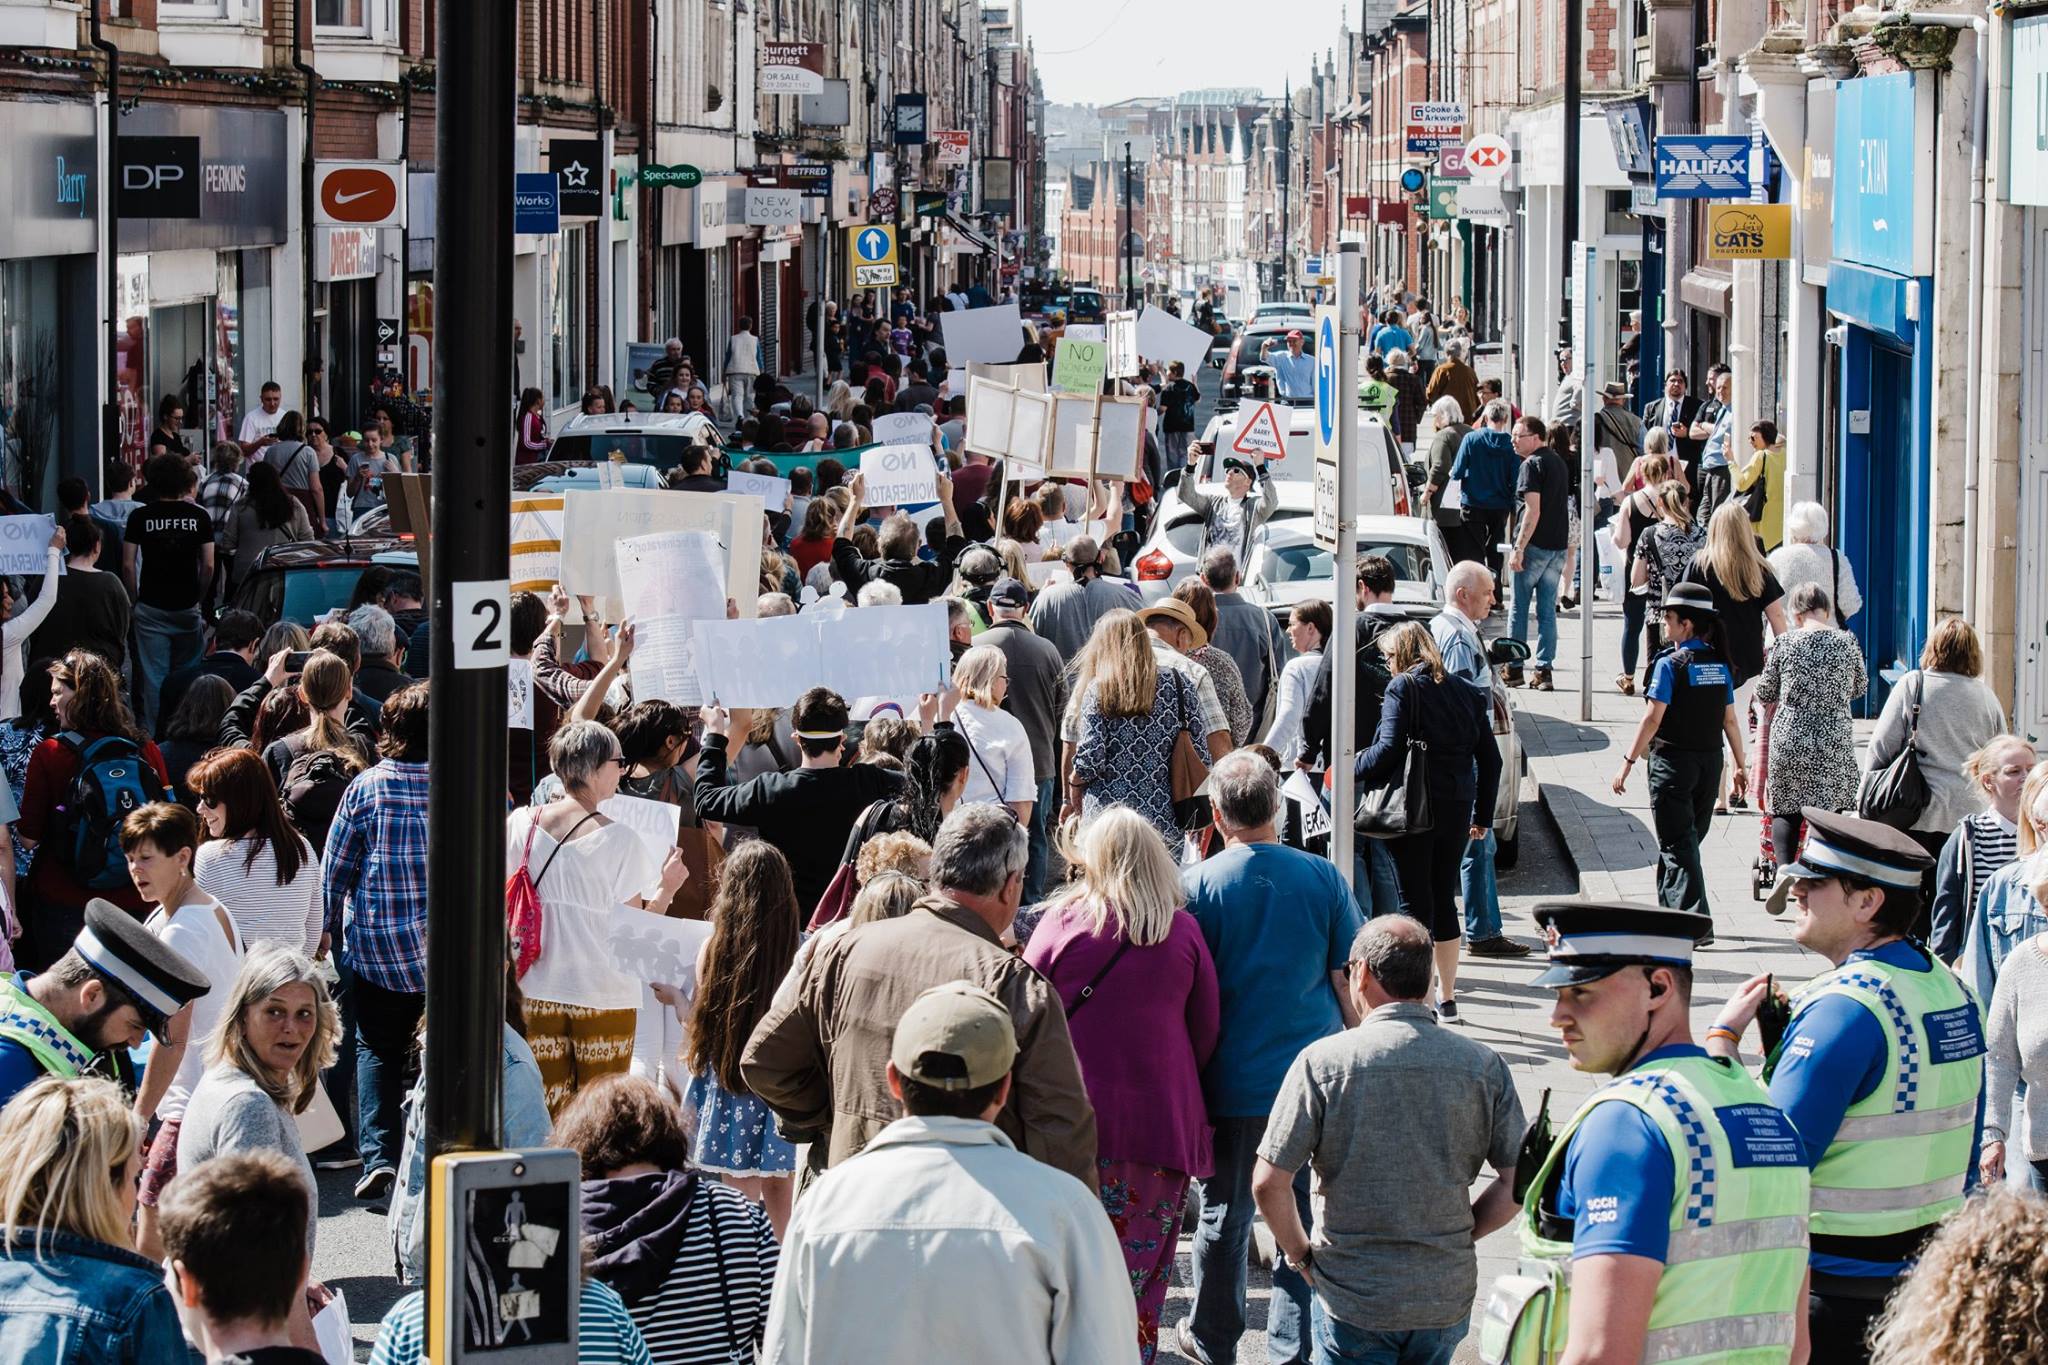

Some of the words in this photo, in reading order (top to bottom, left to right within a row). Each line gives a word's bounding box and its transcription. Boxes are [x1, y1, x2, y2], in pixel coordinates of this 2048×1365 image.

[780, 73, 799, 81] SALE
[787, 167, 828, 176] BETFRED
[1660, 160, 1746, 174] HALIFAX
[124, 165, 184, 189] DP
[206, 165, 246, 193] PERKINS
[644, 169, 696, 182] Specsavers
[56, 156, 87, 218] Barry
[516, 195, 550, 206] Works
[754, 197, 791, 206] NEW
[751, 207, 794, 217] LOOK
[1714, 232, 1764, 247] CATS
[1069, 343, 1094, 362] NO
[1253, 428, 1270, 436] BARRY
[1244, 438, 1277, 448] INCINERATOR
[146, 519, 198, 532] DUFFER
[471, 598, 502, 651] 2
